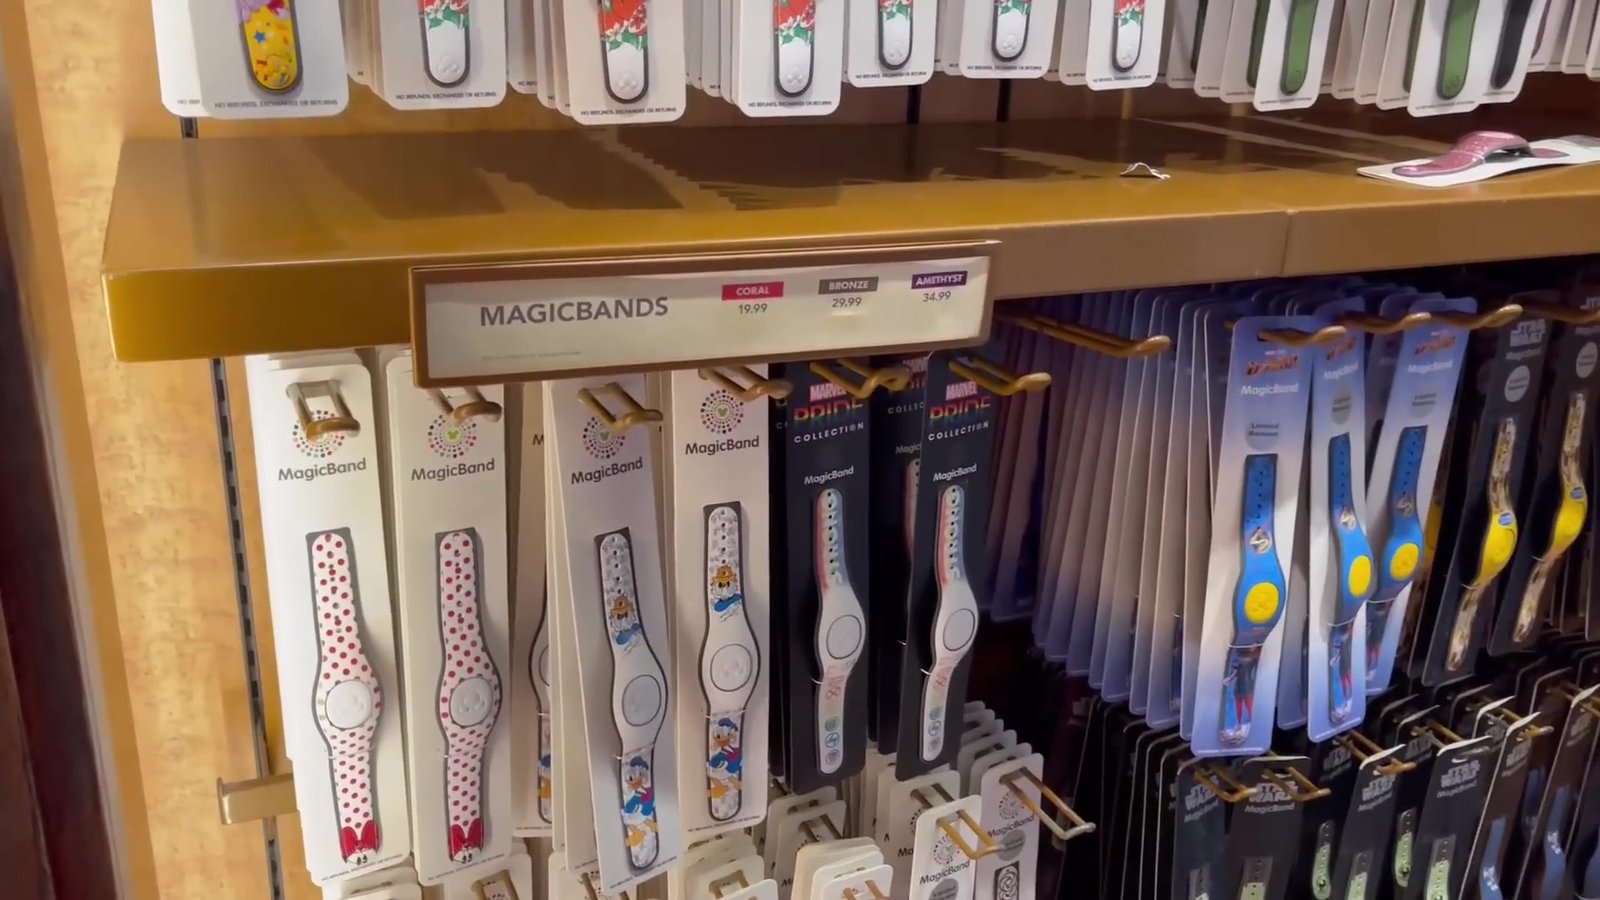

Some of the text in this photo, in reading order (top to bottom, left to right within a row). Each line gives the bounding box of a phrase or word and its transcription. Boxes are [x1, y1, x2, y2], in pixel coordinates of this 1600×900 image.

[828, 280, 869, 291] BRONZE
[915, 273, 964, 287] AMETHYST
[735, 286, 771, 297] CORAL
[922, 291, 951, 303] 34.99
[480, 296, 669, 327] MAGICBANDS
[738, 303, 768, 315] 19.99
[831, 297, 862, 308] 29.99
[810, 381, 848, 401] MARVEL
[945, 380, 979, 400] MARVEL
[1240, 383, 1299, 397] MagicBand
[793, 396, 864, 428] PRIDE
[887, 400, 924, 414] COLLEC
[928, 396, 991, 426] PRIDE
[793, 421, 865, 444] COLLECTION
[928, 420, 989, 441] COLLECTION
[685, 435, 760, 457] MagicBand
[895, 442, 921, 456] Magic
[278, 458, 367, 482] MagicBand
[411, 458, 495, 482] MagicBand
[571, 456, 644, 485] MagicBand
[804, 465, 854, 486] MagicBand
[933, 463, 977, 483] MagicBand
[1244, 802, 1295, 815] MagicBand
[987, 814, 1036, 838] MagicBand
[919, 859, 971, 885] MagicBand
